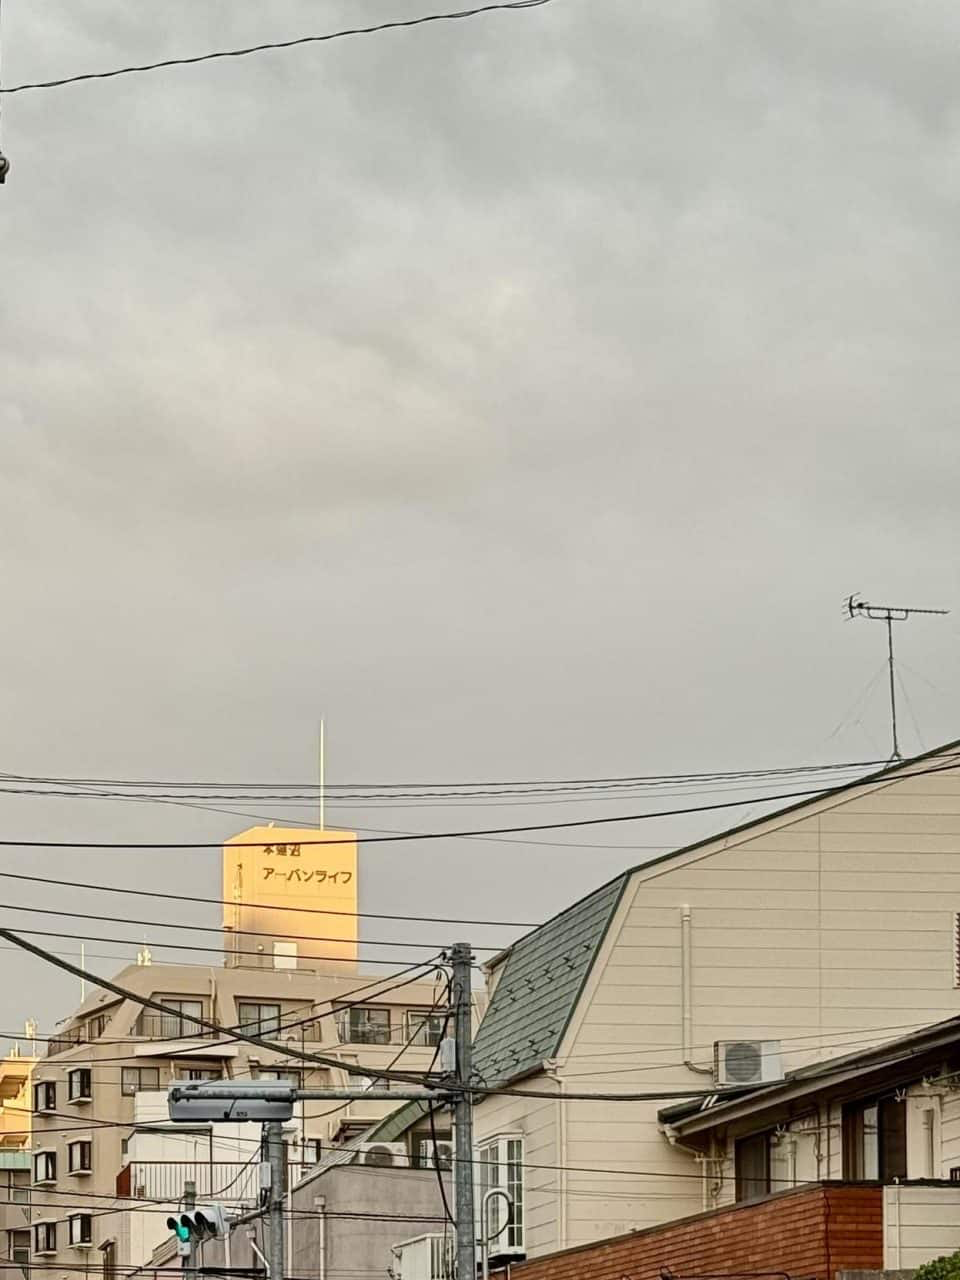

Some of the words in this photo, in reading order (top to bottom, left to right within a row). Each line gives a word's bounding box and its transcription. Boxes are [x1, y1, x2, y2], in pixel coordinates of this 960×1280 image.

[263, 867, 353, 884] アーバンライフ
